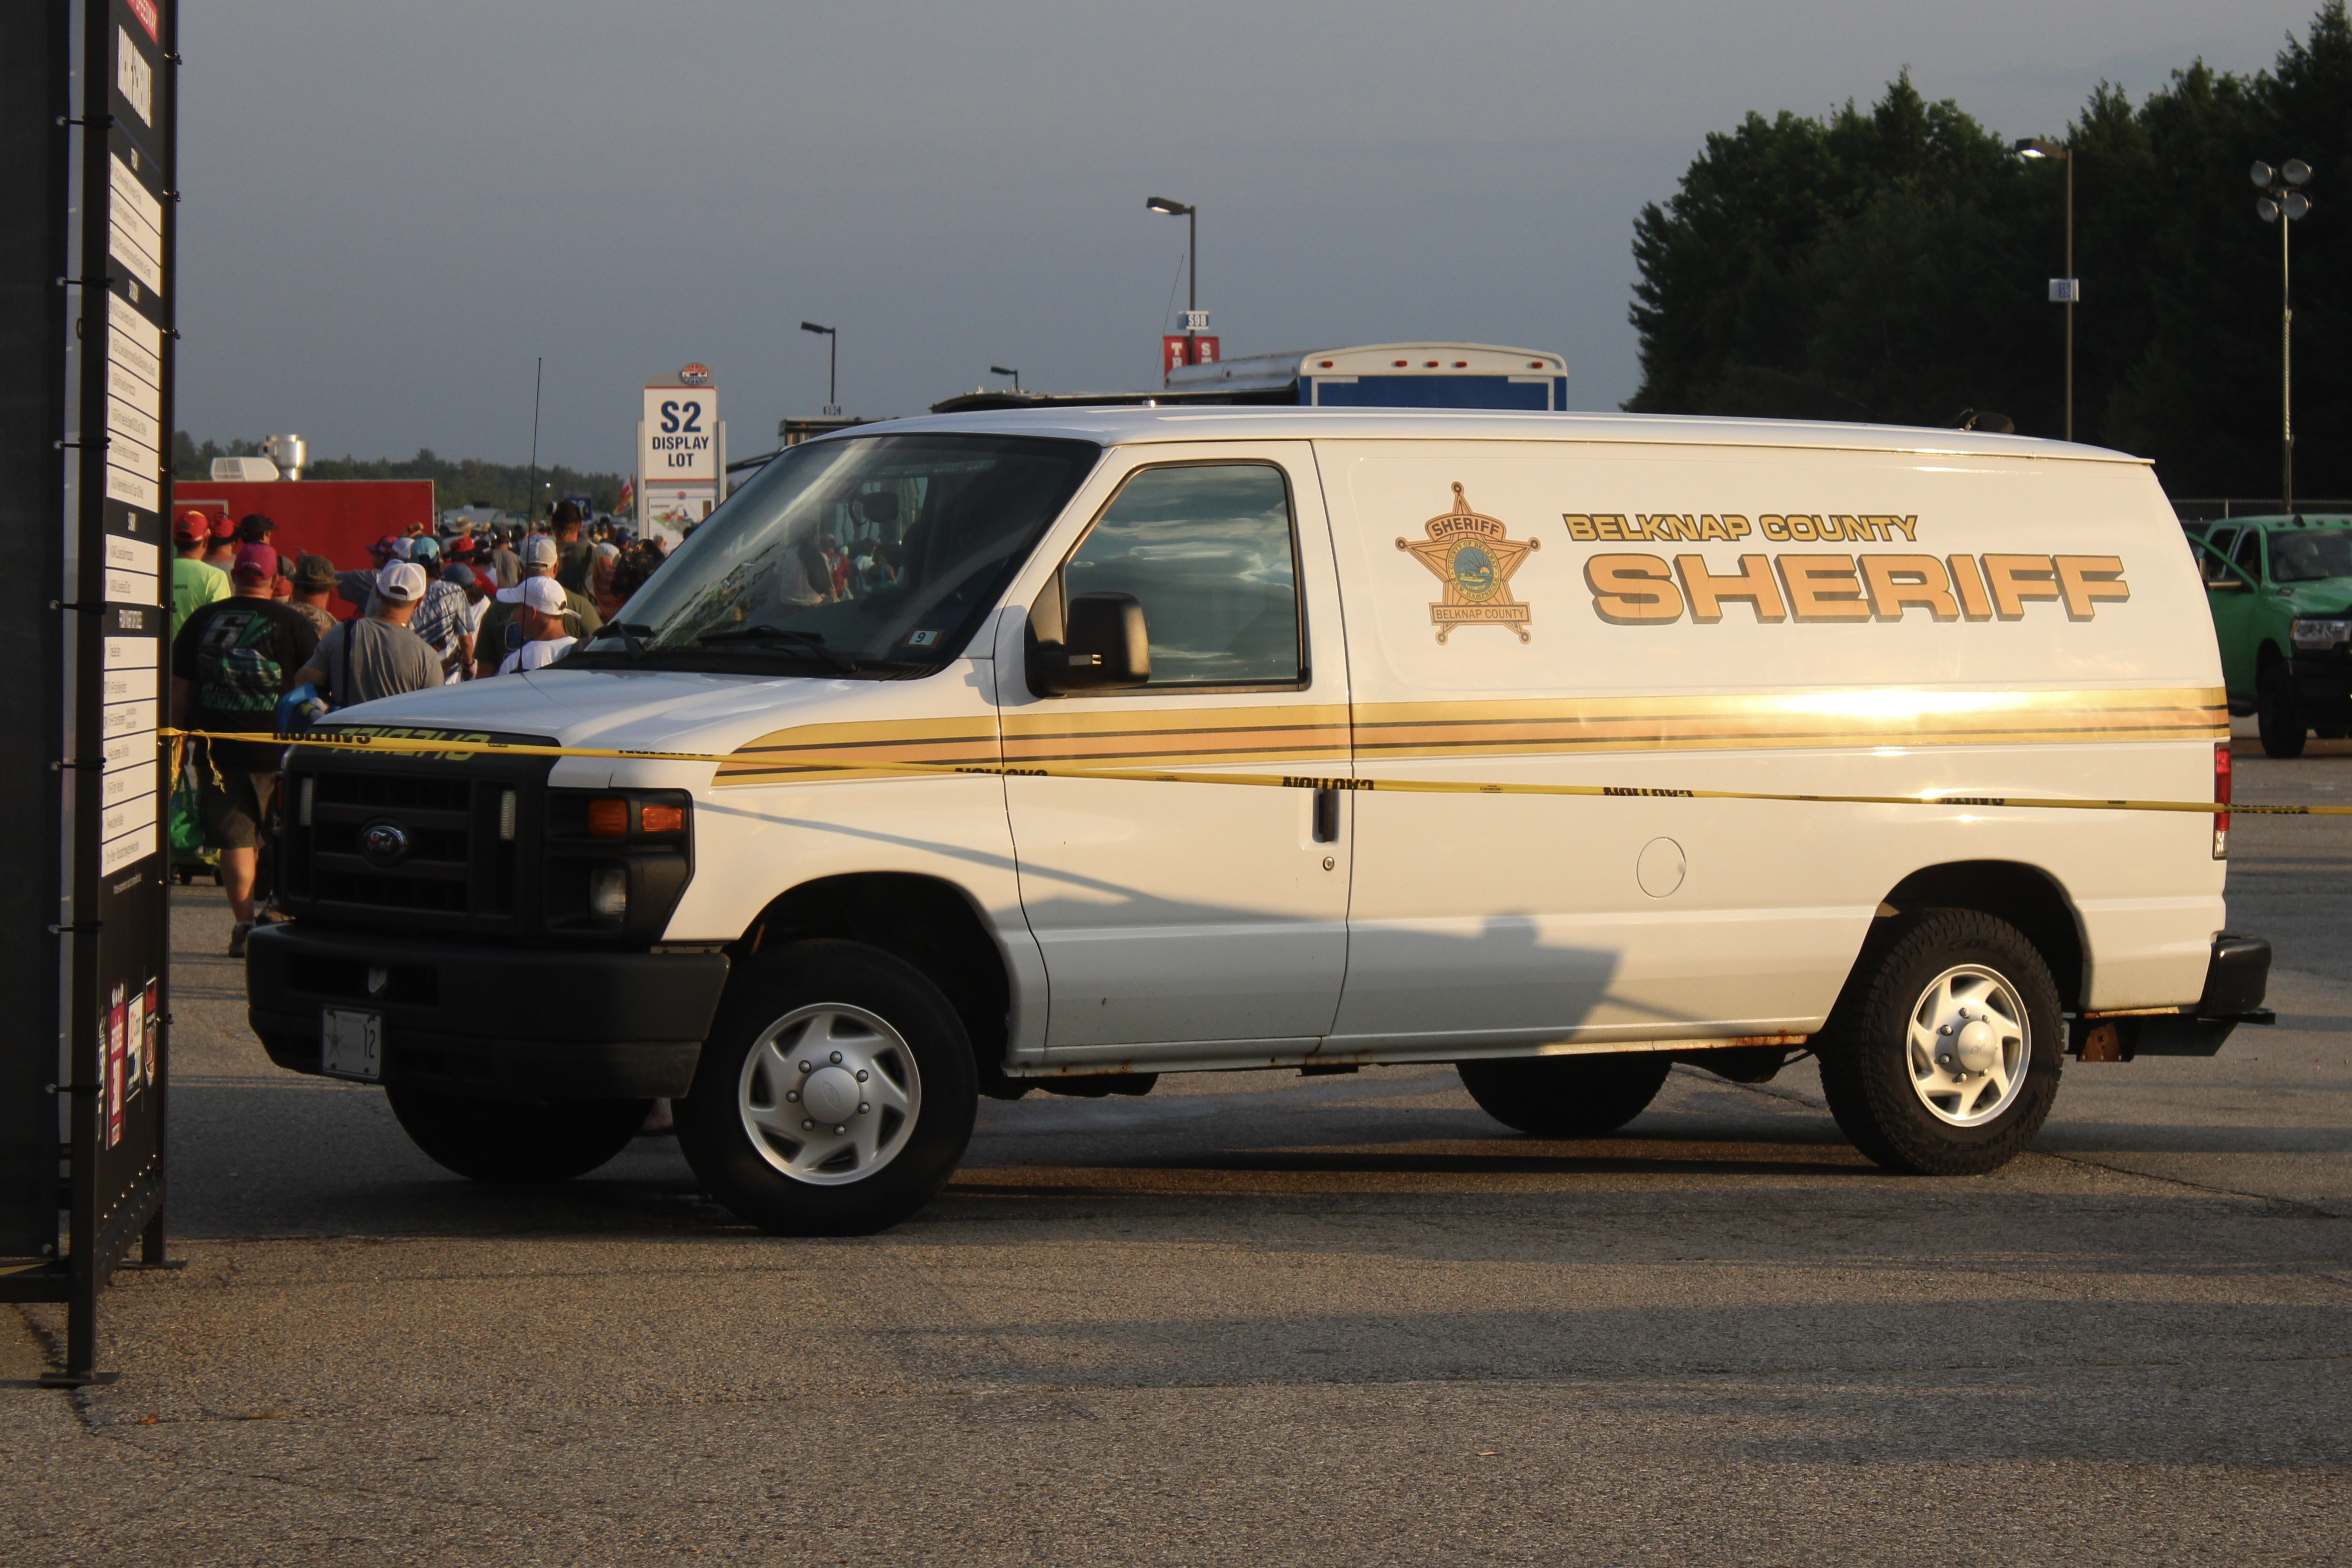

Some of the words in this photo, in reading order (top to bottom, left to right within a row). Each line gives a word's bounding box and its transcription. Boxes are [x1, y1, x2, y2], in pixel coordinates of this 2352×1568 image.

[1188, 314, 1207, 326] S9B
[660, 400, 702, 433] S2
[652, 436, 709, 450] DISPLAY
[668, 453, 694, 467] LOT
[1431, 517, 1500, 537] SHERIFF
[1562, 513, 1752, 542] BELKNAP
[1759, 514, 1919, 542] COUNTY
[1449, 544, 1462, 570] COUNTY
[1474, 542, 1497, 570] BELKNAP
[1453, 578, 1465, 592] NEW
[1467, 578, 1498, 599] HAMPSHIRE
[1583, 553, 2131, 625] SHERIFF
[1436, 609, 1481, 619] BELKNAP
[1485, 608, 1524, 619] COUNTY
[915, 632, 926, 643] 9
[363, 1023, 376, 1059] 12
